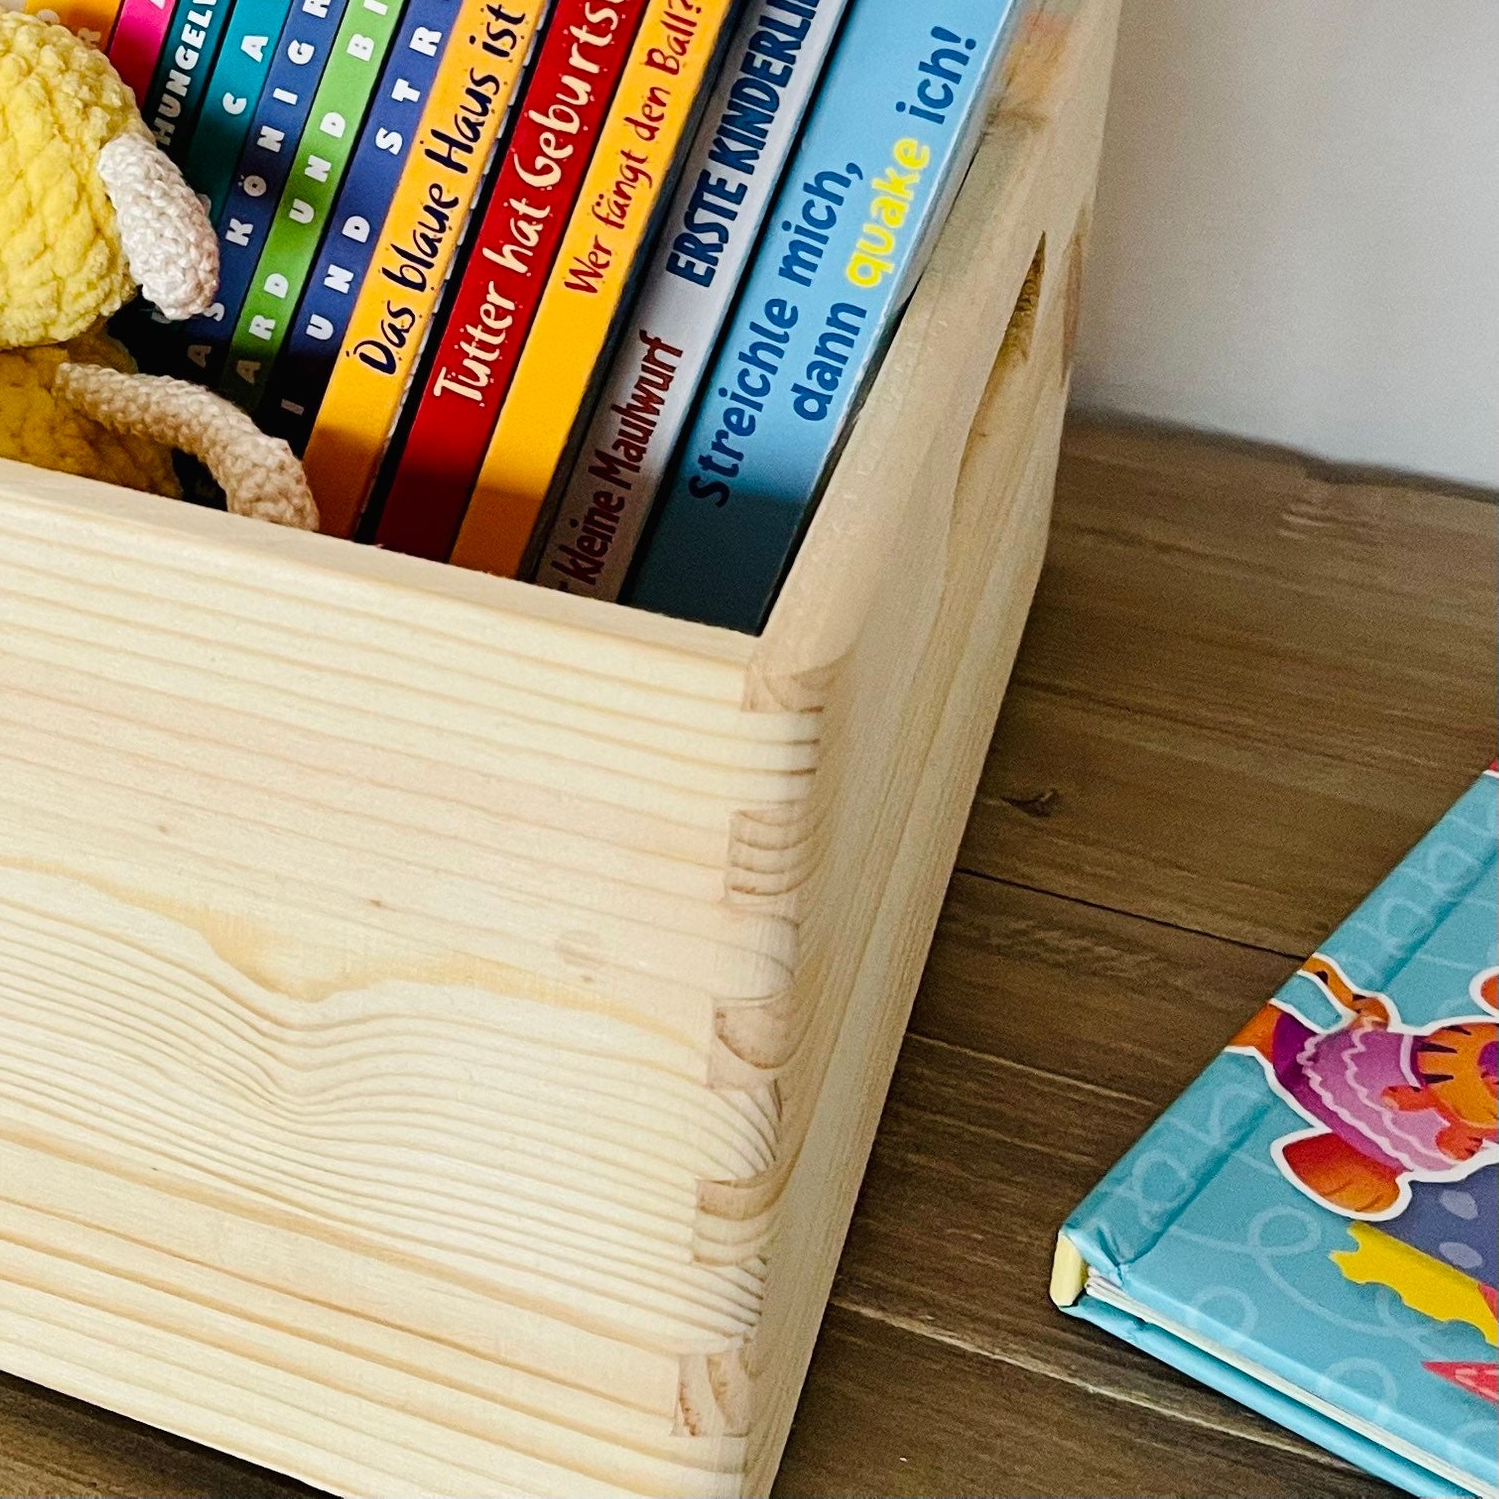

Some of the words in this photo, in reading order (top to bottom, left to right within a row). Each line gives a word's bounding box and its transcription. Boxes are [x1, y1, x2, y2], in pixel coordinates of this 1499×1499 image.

[468, 3, 526, 58] ist
[288, 111, 347, 225] UND
[423, 67, 501, 174] Haus
[381, 182, 460, 293] blaue
[564, 233, 613, 295] Wer
[591, 148, 653, 231] fängt
[623, 85, 671, 143] den
[665, 169, 749, 289] ERSTE
[792, 301, 868, 422] dann
[844, 136, 932, 290] quake
[894, 25, 978, 126] ich!
[305, 215, 372, 341] UND
[353, 298, 416, 376] Das
[433, 280, 516, 404] Tutter
[482, 197, 551, 275] hat
[687, 297, 800, 508] Streichle
[777, 161, 864, 288] mich,
[587, 329, 683, 491] Maulwurf
[550, 487, 625, 586] kleine
